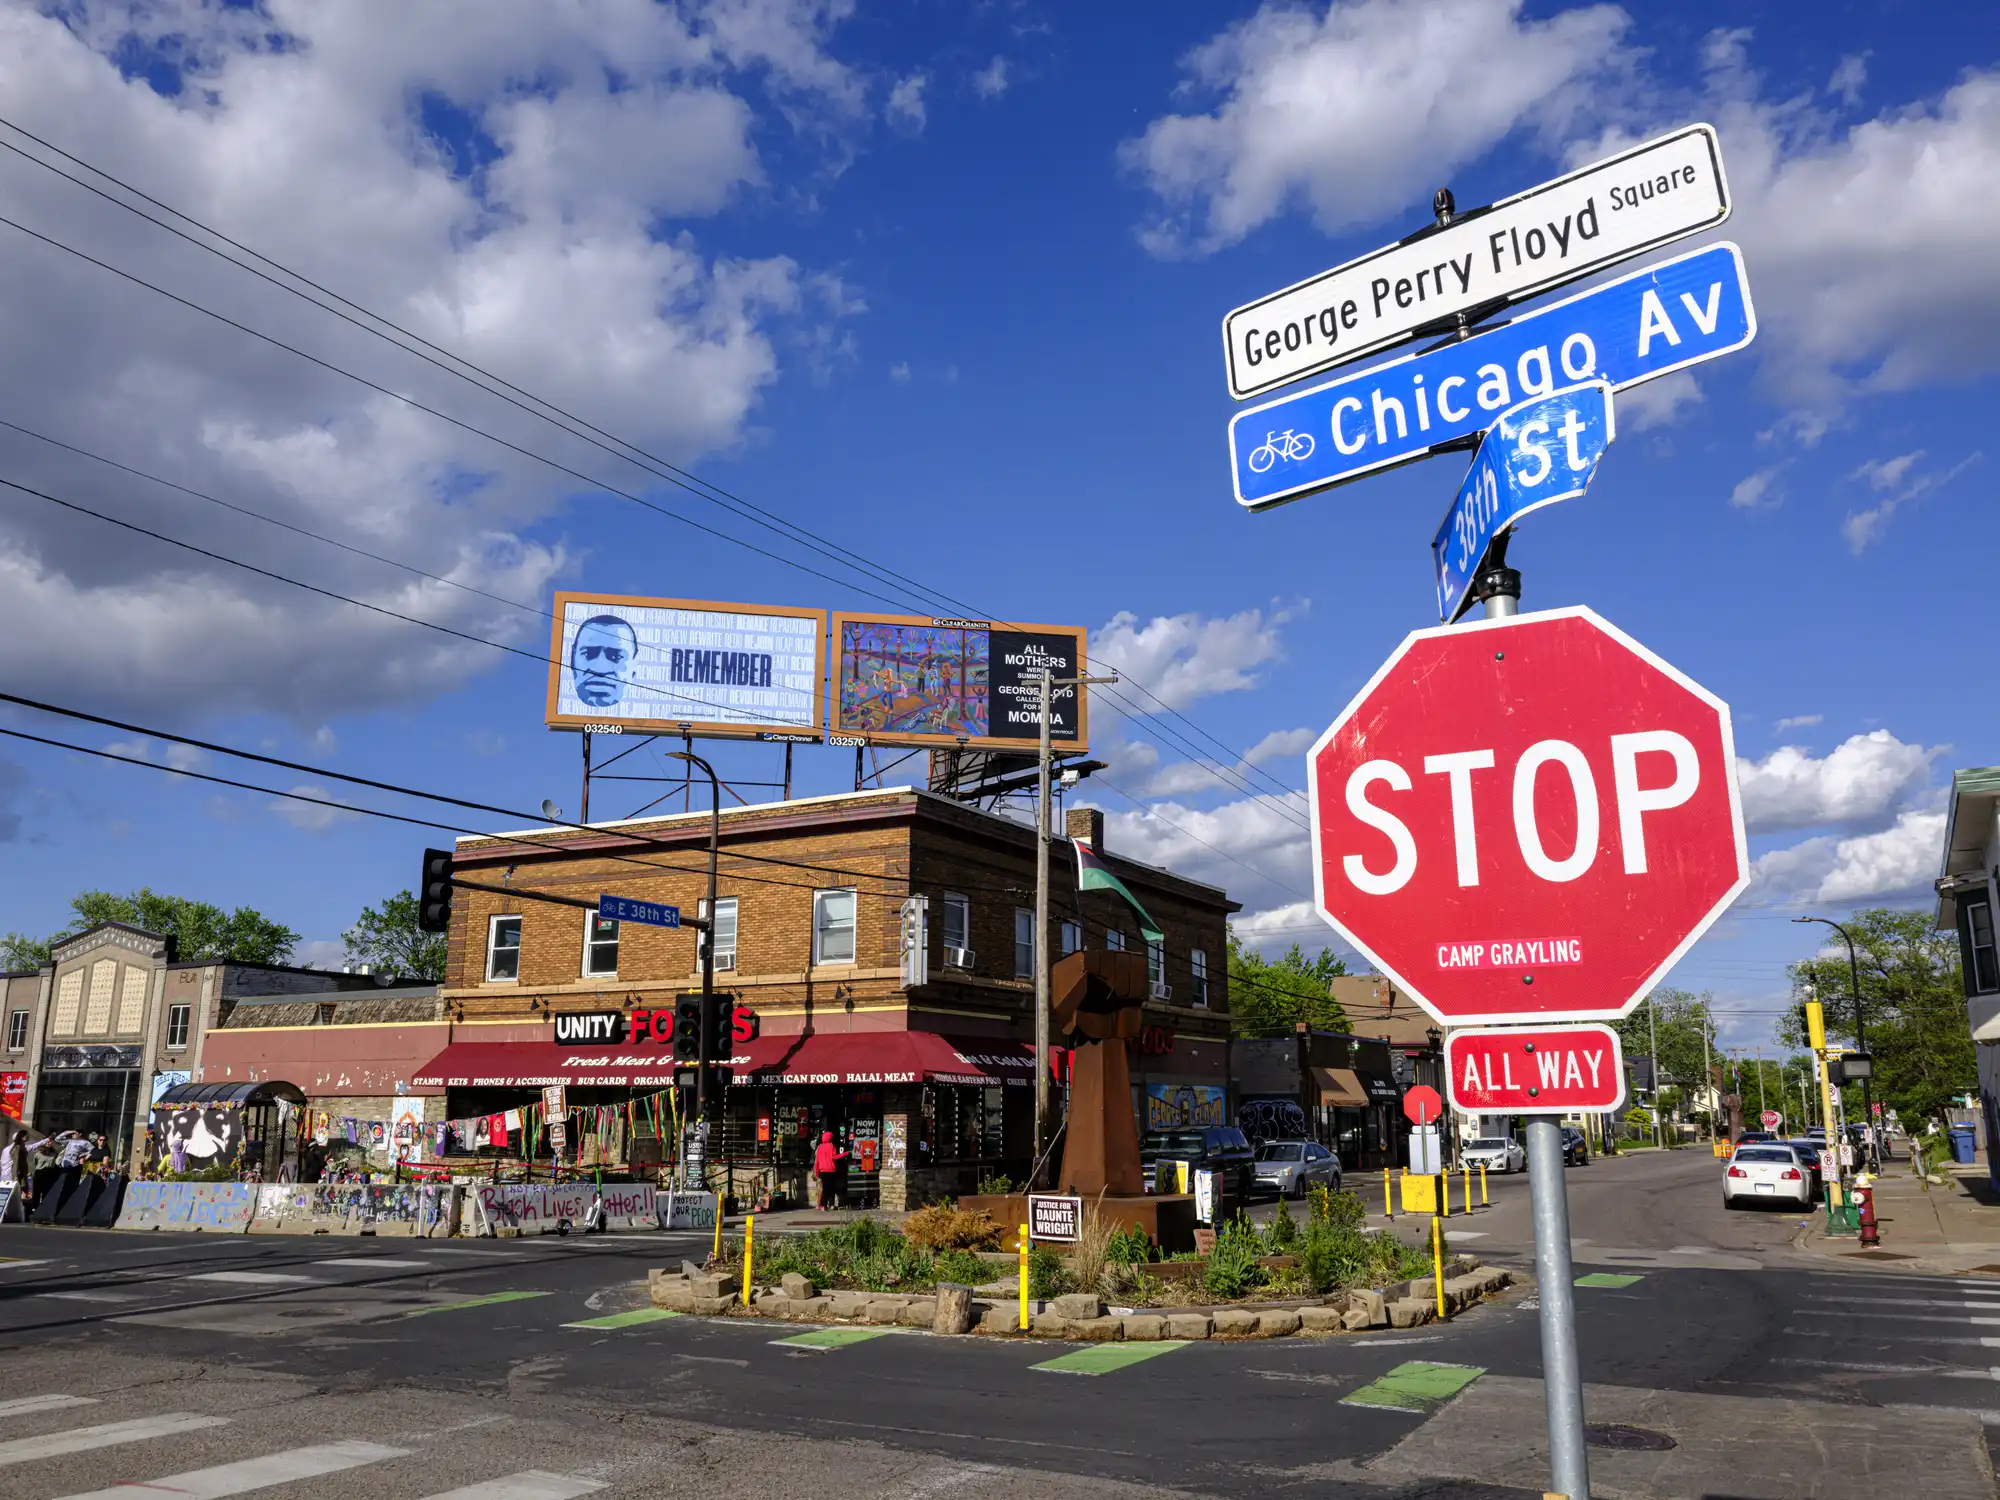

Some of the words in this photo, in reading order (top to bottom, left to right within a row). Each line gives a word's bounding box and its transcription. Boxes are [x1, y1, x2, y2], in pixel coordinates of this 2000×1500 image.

[1245, 299, 1358, 366] George
[1371, 252, 1473, 318] Perry
[1489, 197, 1600, 274] Floyd
[1609, 165, 1696, 211] Square
[1331, 332, 1598, 455] Chicago
[1638, 282, 1722, 358] Av
[1439, 537, 1454, 603] E
[1455, 461, 1499, 573] 38th
[1517, 408, 1589, 488] St
[1023, 644, 1048, 655] ALL
[670, 648, 772, 687] REMEMBER
[1005, 654, 1067, 668] MOTHERS
[1017, 672, 1055, 680] SUMMOD
[998, 686, 1040, 696] GEORGE
[1008, 711, 1064, 725] MOMA
[584, 724, 623, 734] 032540
[829, 736, 866, 747] 032570
[1343, 730, 1701, 896] STOP
[618, 902, 626, 916] E
[631, 904, 660, 921] 38th
[664, 910, 677, 924] St
[1438, 943, 1484, 969] CAMP
[1491, 938, 1581, 966] GRAYLING
[556, 1014, 616, 1040] UNITY
[629, 1007, 753, 1044] FOS
[561, 1056, 608, 1067] Fresh
[610, 1056, 652, 1066] Meat
[656, 1056, 674, 1066] &
[1020, 1057, 1037, 1067] De
[1462, 1052, 1521, 1092] ALL
[1536, 1048, 1604, 1090] WAY
[412, 1077, 444, 1086] STAMPS
[447, 1077, 469, 1086] KEYS
[473, 1077, 505, 1086] PHONES
[506, 1077, 514, 1086] &
[515, 1077, 572, 1086] ACCESSORIES
[577, 1077, 595, 1086] BUS
[596, 1076, 628, 1085] CARDS
[761, 1074, 809, 1084] MEXICAN
[810, 1073, 839, 1083] FOOD
[846, 1073, 882, 1082] HALAL
[884, 1072, 915, 1082] MEAT
[958, 1074, 985, 1084] EASTERN
[985, 1076, 1002, 1085] FOOD
[1007, 1078, 1027, 1086] CHEESE
[780, 1107, 808, 1119] GLA
[1762, 1114, 1777, 1122] STOP
[777, 1121, 798, 1135] CBD
[855, 1128, 876, 1136] OPEN
[128, 1182, 169, 1209] STOP
[673, 1195, 703, 1205] PROTECT
[356, 1206, 375, 1218] WILL
[676, 1205, 690, 1216] OUR
[1037, 1200, 1059, 1209] JUSTICE
[1060, 1202, 1072, 1210] FOR
[167, 1200, 241, 1227] VIOLENCE
[692, 1207, 718, 1227] PEOPL
[1036, 1208, 1074, 1222] DAUNTE
[1036, 1221, 1075, 1235] WRIGHT
